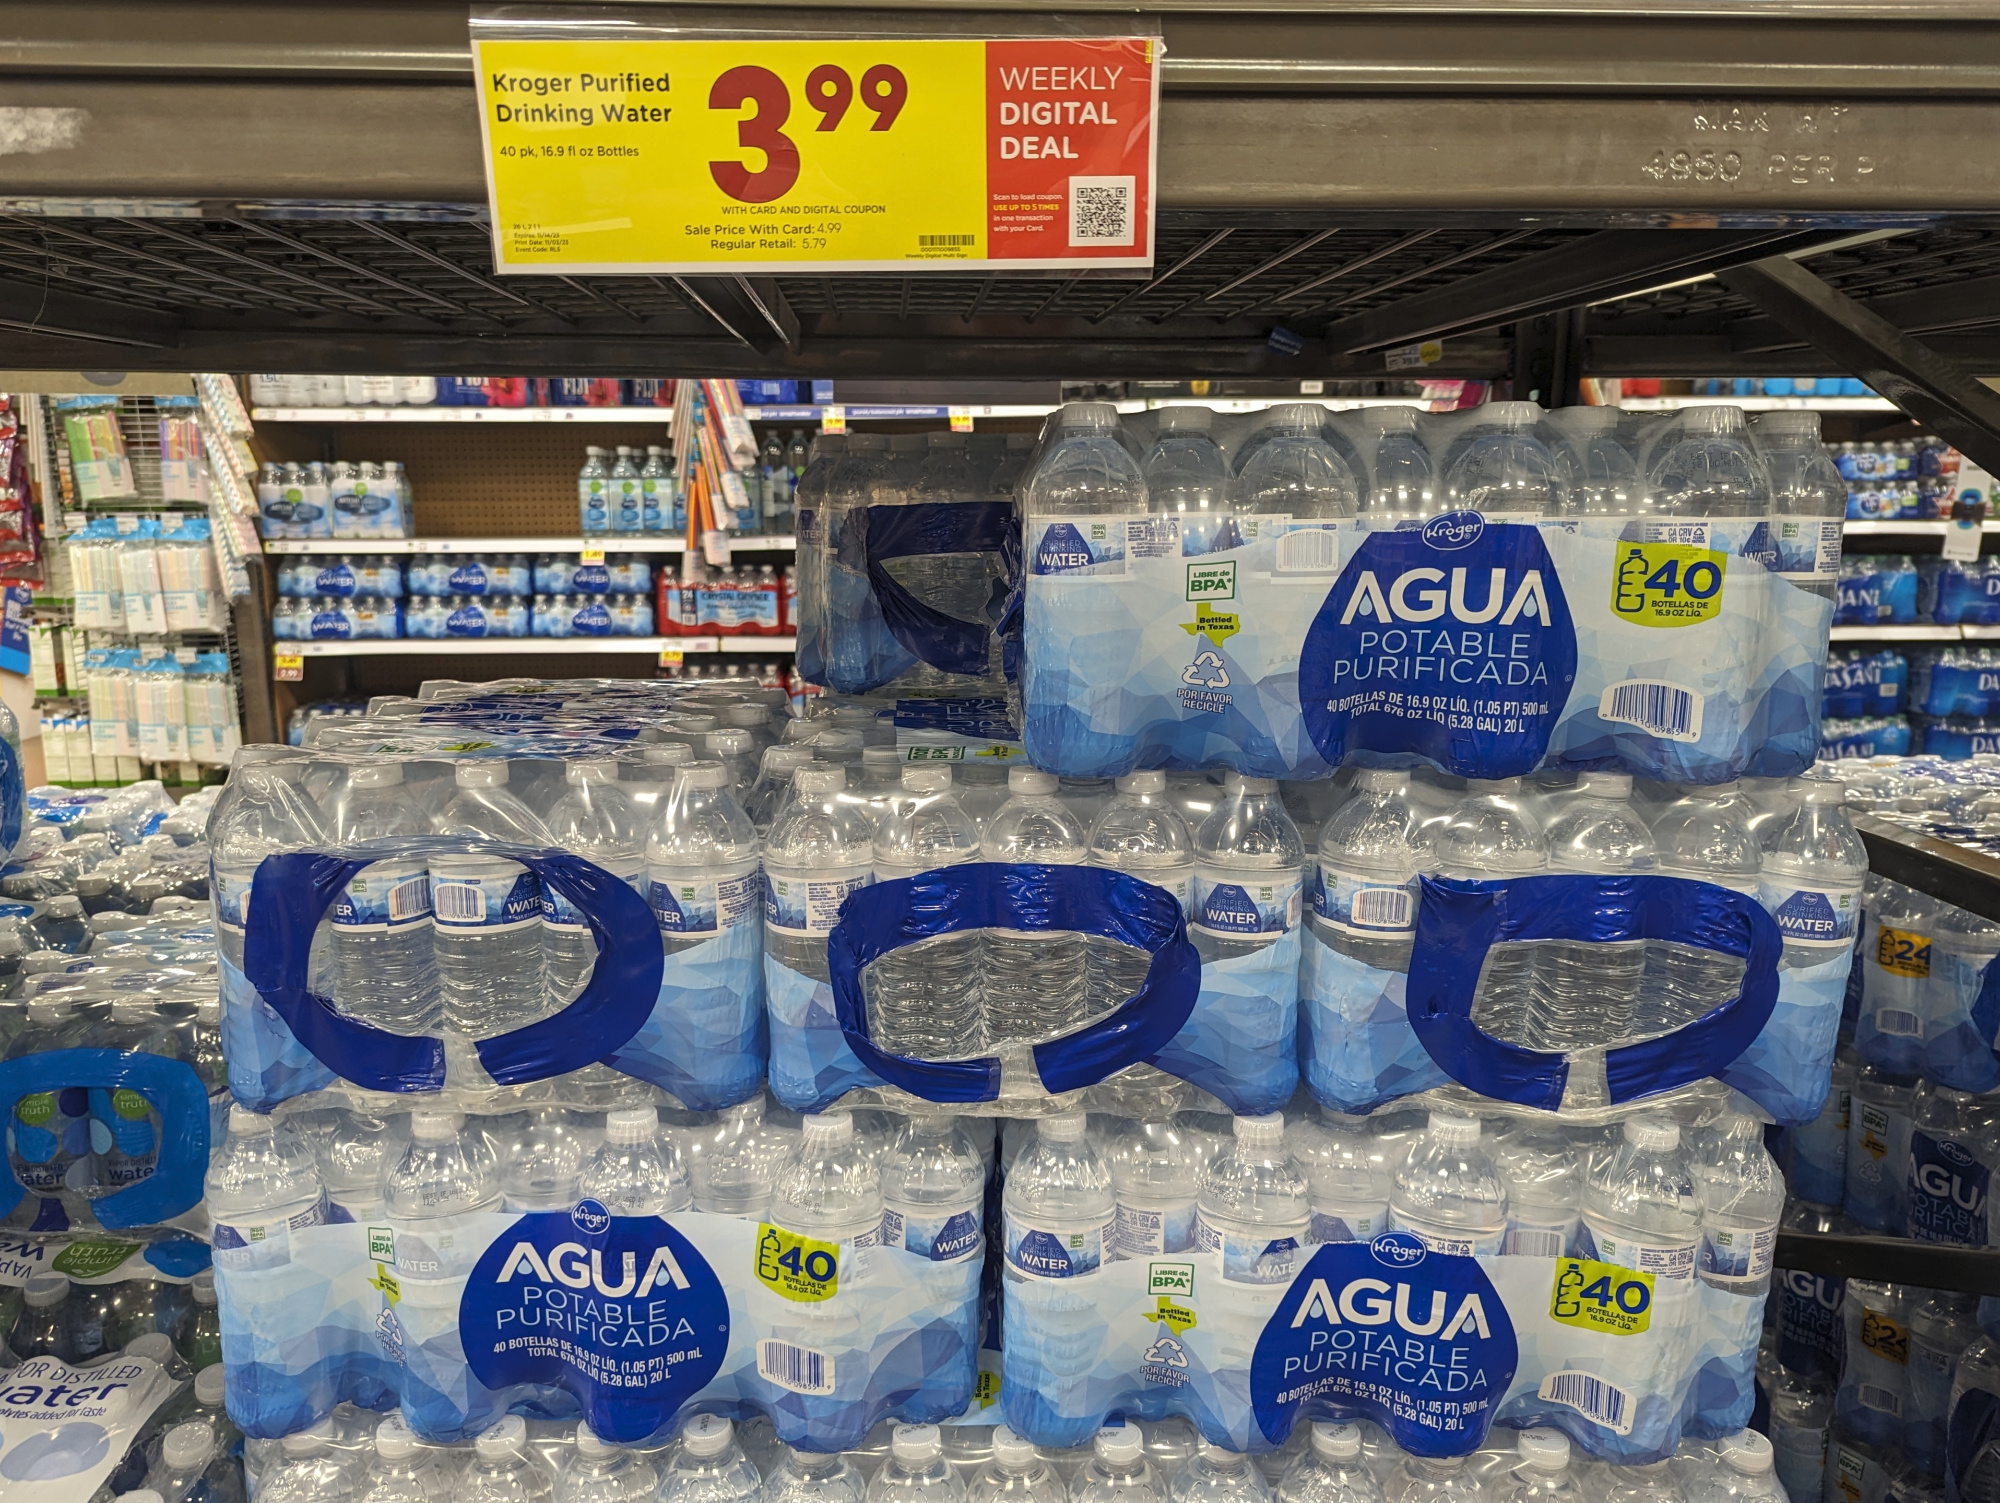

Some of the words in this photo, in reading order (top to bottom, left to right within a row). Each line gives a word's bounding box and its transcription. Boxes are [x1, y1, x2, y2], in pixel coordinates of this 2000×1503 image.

[493, 73, 572, 96] Kroger
[580, 72, 671, 93] Purified
[999, 66, 1123, 91] WEEKLY
[496, 104, 594, 126] Drinking
[601, 103, 672, 122] Water
[1000, 101, 1118, 126] DIGITAL
[500, 146, 516, 157] 40
[520, 145, 538, 159] pk,
[542, 146, 565, 157] 16.9
[568, 145, 576, 157] fl
[579, 148, 594, 157] oz
[597, 145, 640, 157] Bottles
[1000, 135, 1079, 160] DEAL
[1036, 194, 1064, 202] coupon.
[1038, 203, 1060, 211] TIMES
[721, 206, 747, 215] WITH
[750, 205, 777, 215] CARD
[780, 205, 801, 215] AND
[804, 205, 841, 214] DIGITAL
[844, 205, 886, 214] COUPON
[684, 225, 711, 236] Sale
[714, 224, 746, 235] Price
[749, 224, 779, 235] With
[782, 223, 816, 234] Card:
[817, 223, 842, 234] 4.99
[711, 239, 755, 251] Regular
[759, 239, 796, 249] Retail:
[802, 238, 827, 249] 5.79
[1426, 521, 1481, 543] Kroger
[1040, 553, 1089, 566] WATER
[1193, 571, 1218, 579] LIBRE
[1644, 559, 1722, 600] 40
[1340, 567, 1552, 627] AGUA
[1651, 600, 1696, 609] BOTELLAS
[1696, 602, 1709, 610] DE
[1199, 616, 1232, 624] Bottled
[1654, 609, 1671, 617] 16.9
[1671, 609, 1685, 617] OZ
[1686, 608, 1703, 618] LÍQ.
[1359, 630, 1531, 659] POTABLE
[1334, 657, 1548, 686] PURIFICADA
[1176, 688, 1198, 699] POR
[1200, 691, 1233, 705] FAVOR
[1327, 699, 1338, 713] 40
[1338, 691, 1386, 712] BOTELLAS
[1389, 692, 1403, 705] DE
[1407, 694, 1429, 708] 16.9
[1432, 696, 1447, 710] OZ
[1450, 695, 1470, 713] LÍQ.
[1473, 701, 1500, 716] (1.05
[1503, 702, 1520, 718] PT)
[1522, 702, 1538, 716] 500
[1182, 700, 1226, 714] RECICLE
[1351, 703, 1381, 720] TOTAL
[1384, 704, 1404, 717] 676
[1406, 710, 1422, 719] OZ
[1426, 709, 1445, 726] LÍQ
[1448, 714, 1474, 729] (5.28
[1476, 717, 1502, 735] GAL)
[1503, 719, 1517, 733] 20
[1518, 719, 1525, 733] L
[1206, 908, 1257, 924] WATER
[1778, 914, 1834, 932] WATER
[1895, 939, 1932, 966] 24
[575, 1206, 608, 1228] Kroger
[937, 1230, 978, 1253] WATER
[1374, 1238, 1424, 1262] Kroger
[496, 1241, 691, 1299] AGUA
[778, 1246, 837, 1282] 40
[1020, 1250, 1068, 1270] WATER
[783, 1274, 816, 1289] BOTELLAS
[817, 1282, 827, 1291] DE
[1155, 1269, 1178, 1277] LIBRE
[786, 1283, 798, 1293] 16.9
[799, 1286, 809, 1294] OZ
[810, 1287, 823, 1297] LÍQ.
[1579, 1275, 1651, 1315] 40
[524, 1287, 668, 1326] POTABLE
[1159, 1307, 1191, 1317] Bottled
[1290, 1278, 1492, 1341] AGUA
[1586, 1306, 1626, 1322] BOTELLAS
[1627, 1315, 1639, 1324] DE
[496, 1307, 695, 1348] PURIFICADA
[1168, 1314, 1192, 1324] Texas
[1590, 1313, 1605, 1324] 16.9
[1605, 1318, 1617, 1326] OZ
[1618, 1320, 1633, 1331] LÍQ.
[493, 1342, 506, 1354] 40
[508, 1336, 560, 1351] BOTELLAS
[561, 1339, 573, 1352] DE
[574, 1345, 589, 1361] 16.9
[590, 1353, 600, 1366] OZ
[601, 1354, 619, 1372] LÍQ.
[621, 1360, 646, 1376] (1.05
[648, 1357, 664, 1371] PT)
[666, 1352, 685, 1367] 500
[687, 1347, 703, 1360] mL
[1311, 1329, 1470, 1368] POTABLE
[50, 1365, 142, 1384] DISTILLED
[1140, 1365, 1160, 1376] POR
[1161, 1367, 1191, 1384] FAVOR
[1145, 1373, 1184, 1388] RECICLE
[1284, 1351, 1488, 1392] PURIFICADA
[1276, 1392, 1288, 1405] 40
[1288, 1376, 1335, 1402] BOTELLAS
[1337, 1376, 1350, 1387] DE
[1353, 1380, 1376, 1393] 16.9
[1378, 1385, 1393, 1400] OZ
[1394, 1390, 1414, 1407] LÍQ.
[1416, 1399, 1442, 1415] (1.05
[1444, 1403, 1460, 1418] PT)
[1462, 1401, 1478, 1416] 500
[29, 1409, 66, 1420] added
[81, 1406, 107, 1417] taste
